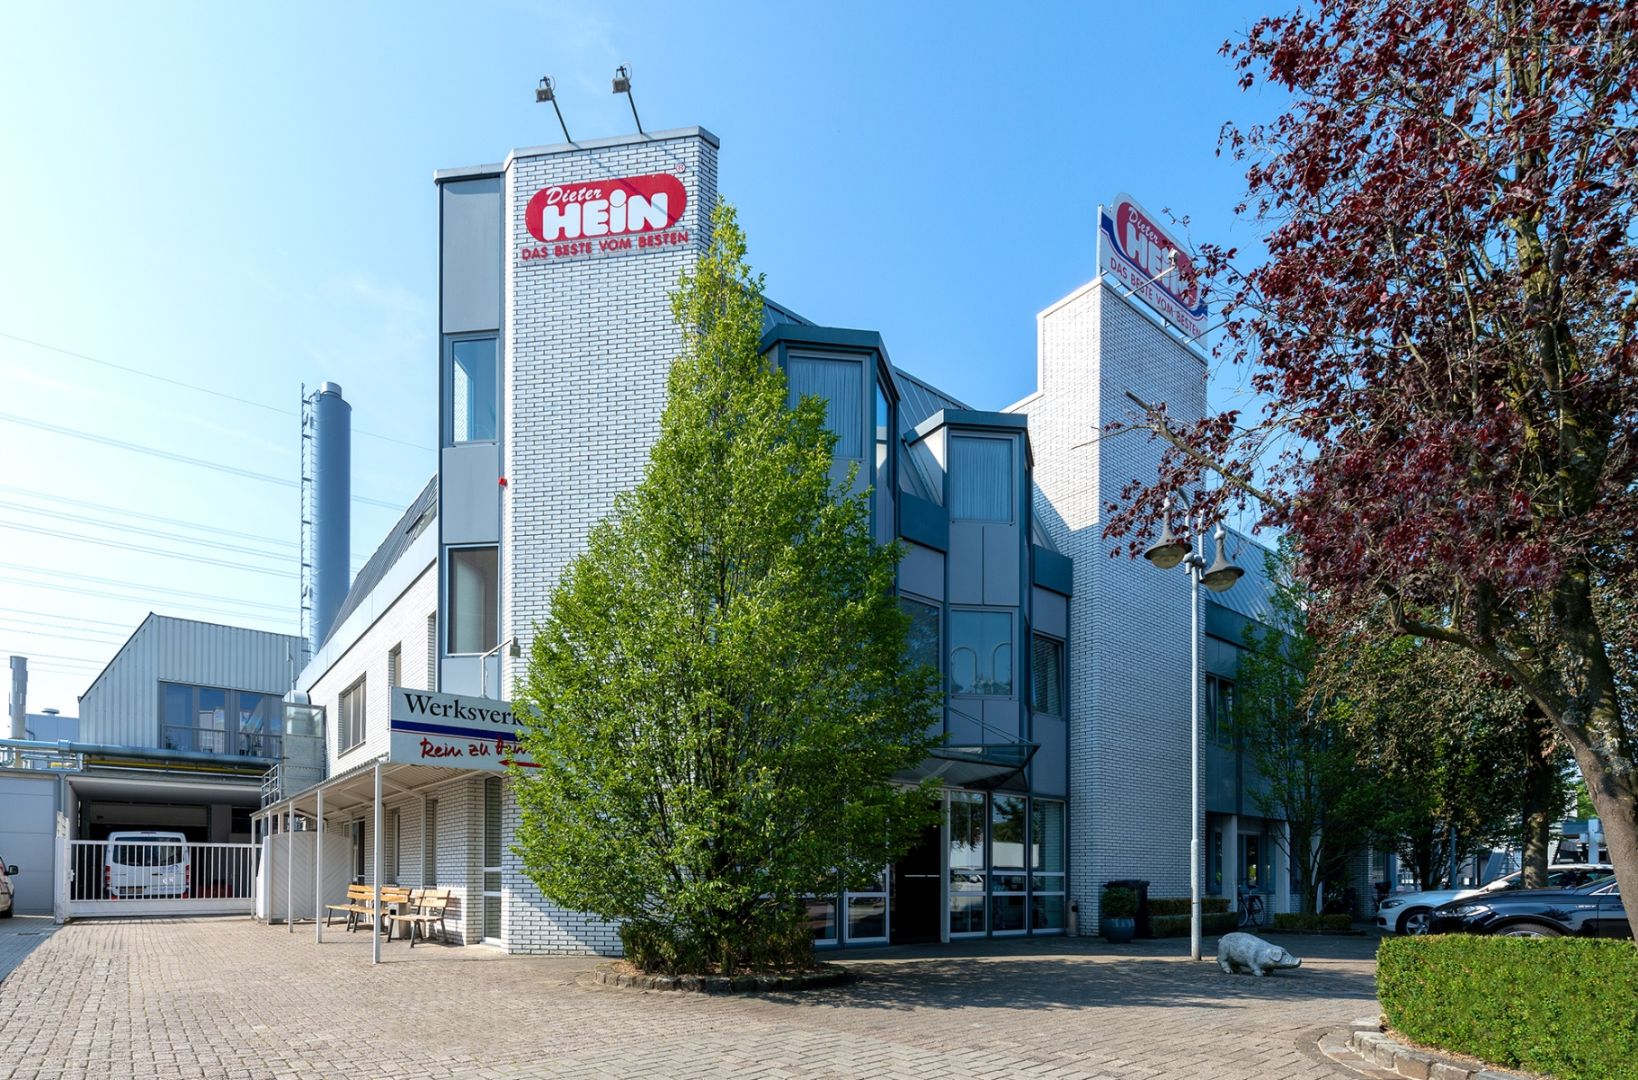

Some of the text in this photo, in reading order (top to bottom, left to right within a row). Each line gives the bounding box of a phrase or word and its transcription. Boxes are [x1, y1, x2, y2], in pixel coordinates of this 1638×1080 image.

[545, 187, 602, 205] Dieter
[1128, 206, 1158, 244] Dieter
[521, 231, 689, 261] DAS BESTE VOM BESTEN
[1110, 257, 1128, 279] DAS
[1155, 293, 1174, 318] VOM
[1176, 310, 1202, 336] BESTEN
[420, 737, 463, 759] Rein
[468, 742, 491, 757] zu
